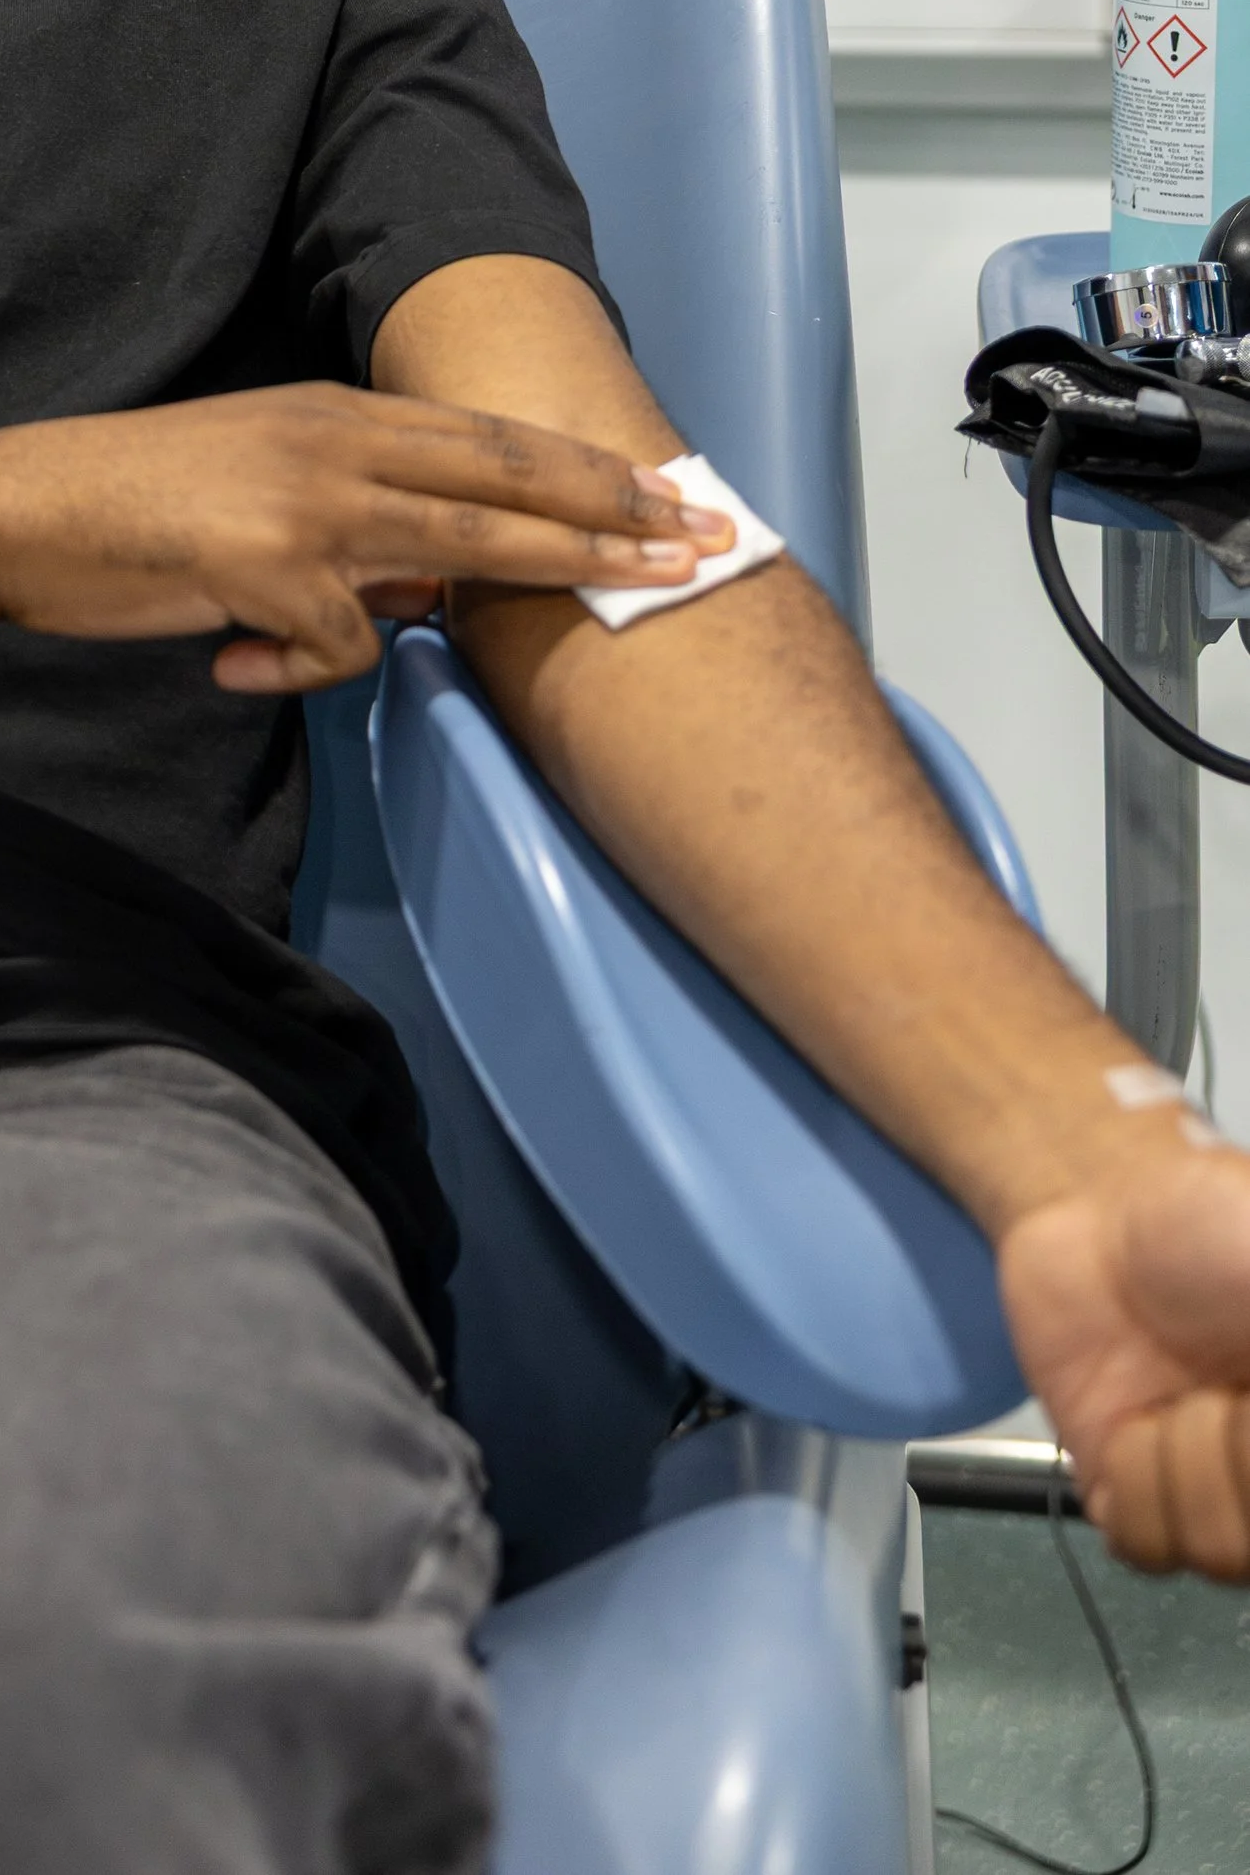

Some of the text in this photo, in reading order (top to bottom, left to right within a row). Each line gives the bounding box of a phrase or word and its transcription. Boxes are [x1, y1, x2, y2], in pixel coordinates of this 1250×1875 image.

[1134, 13, 1155, 21] Danger
[1159, 191, 1205, 199] www.ecolab.com
[1140, 311, 1152, 319] 5
